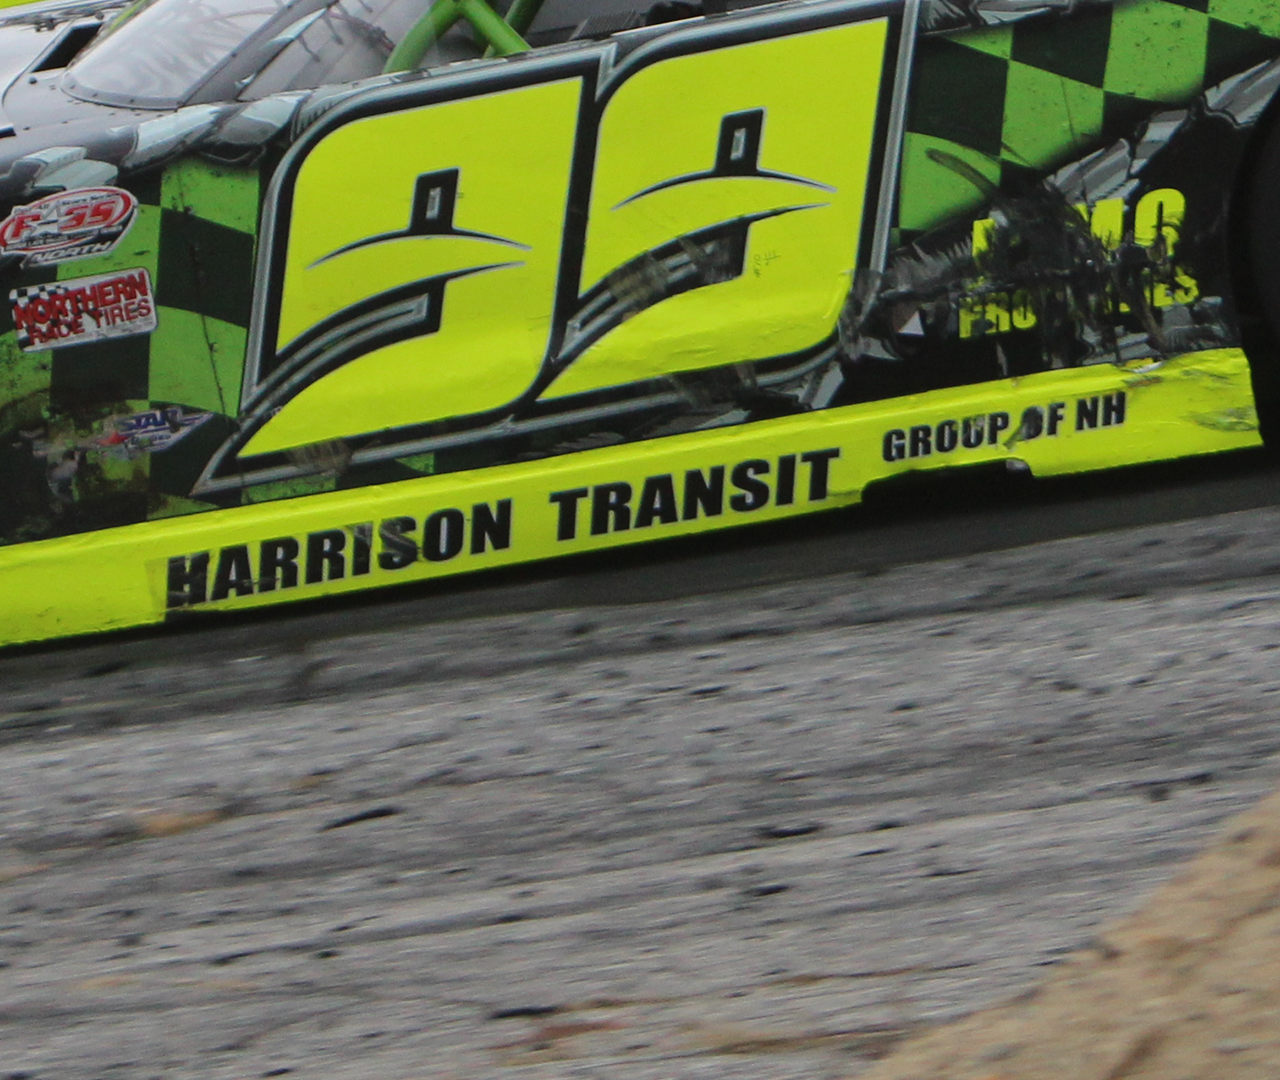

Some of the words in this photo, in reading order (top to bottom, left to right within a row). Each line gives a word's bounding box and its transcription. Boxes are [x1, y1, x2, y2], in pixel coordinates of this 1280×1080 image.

[31, 241, 112, 264] NORTH
[236, 17, 890, 458] 99
[13, 270, 149, 330] NORTHERN
[28, 314, 86, 346] RACE
[91, 297, 152, 328] TIRES
[165, 496, 513, 608] HARRISON
[548, 447, 842, 542] TRANSIT
[881, 411, 1009, 462] GROUP
[1010, 404, 1067, 444] OF
[1075, 392, 1129, 431] NH
